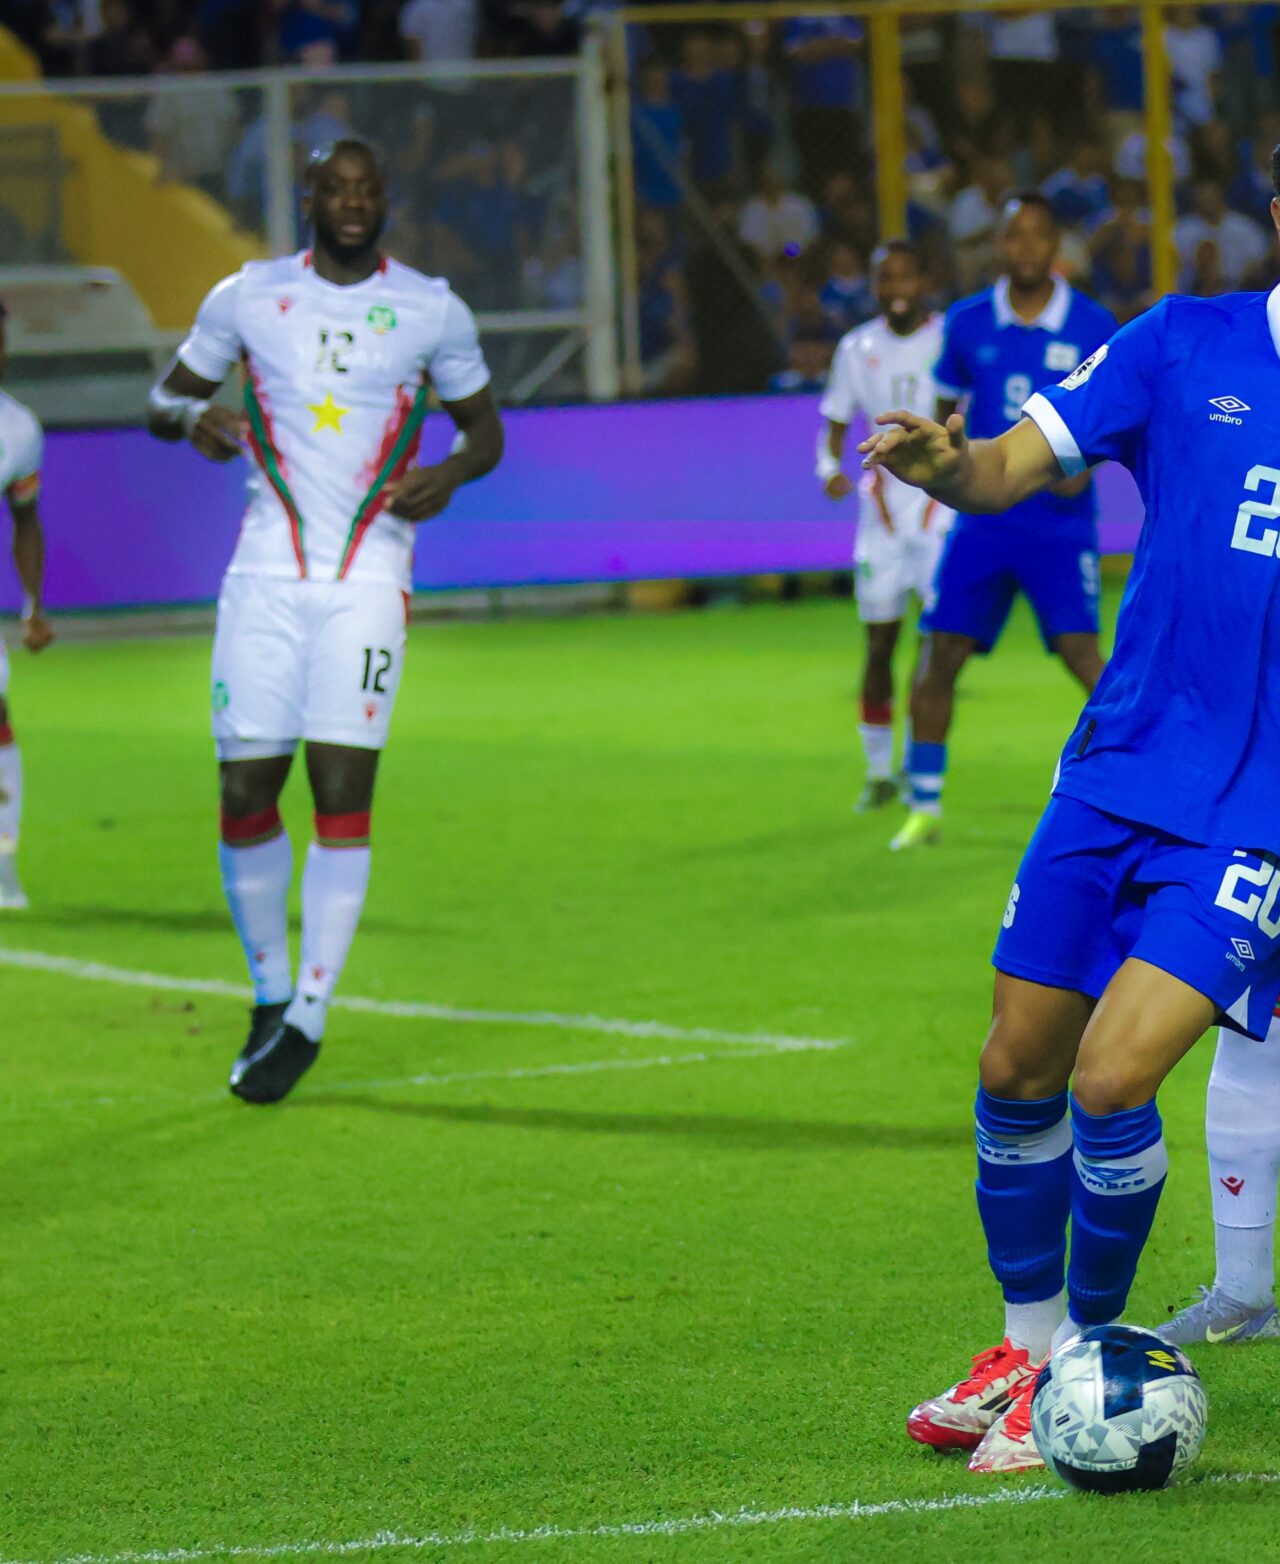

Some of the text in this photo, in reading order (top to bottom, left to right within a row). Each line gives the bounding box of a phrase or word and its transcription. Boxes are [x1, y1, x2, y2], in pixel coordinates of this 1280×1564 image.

[316, 330, 353, 373] 12
[1004, 374, 1032, 421] 9
[1208, 412, 1243, 426] umbro
[362, 647, 391, 693] 12
